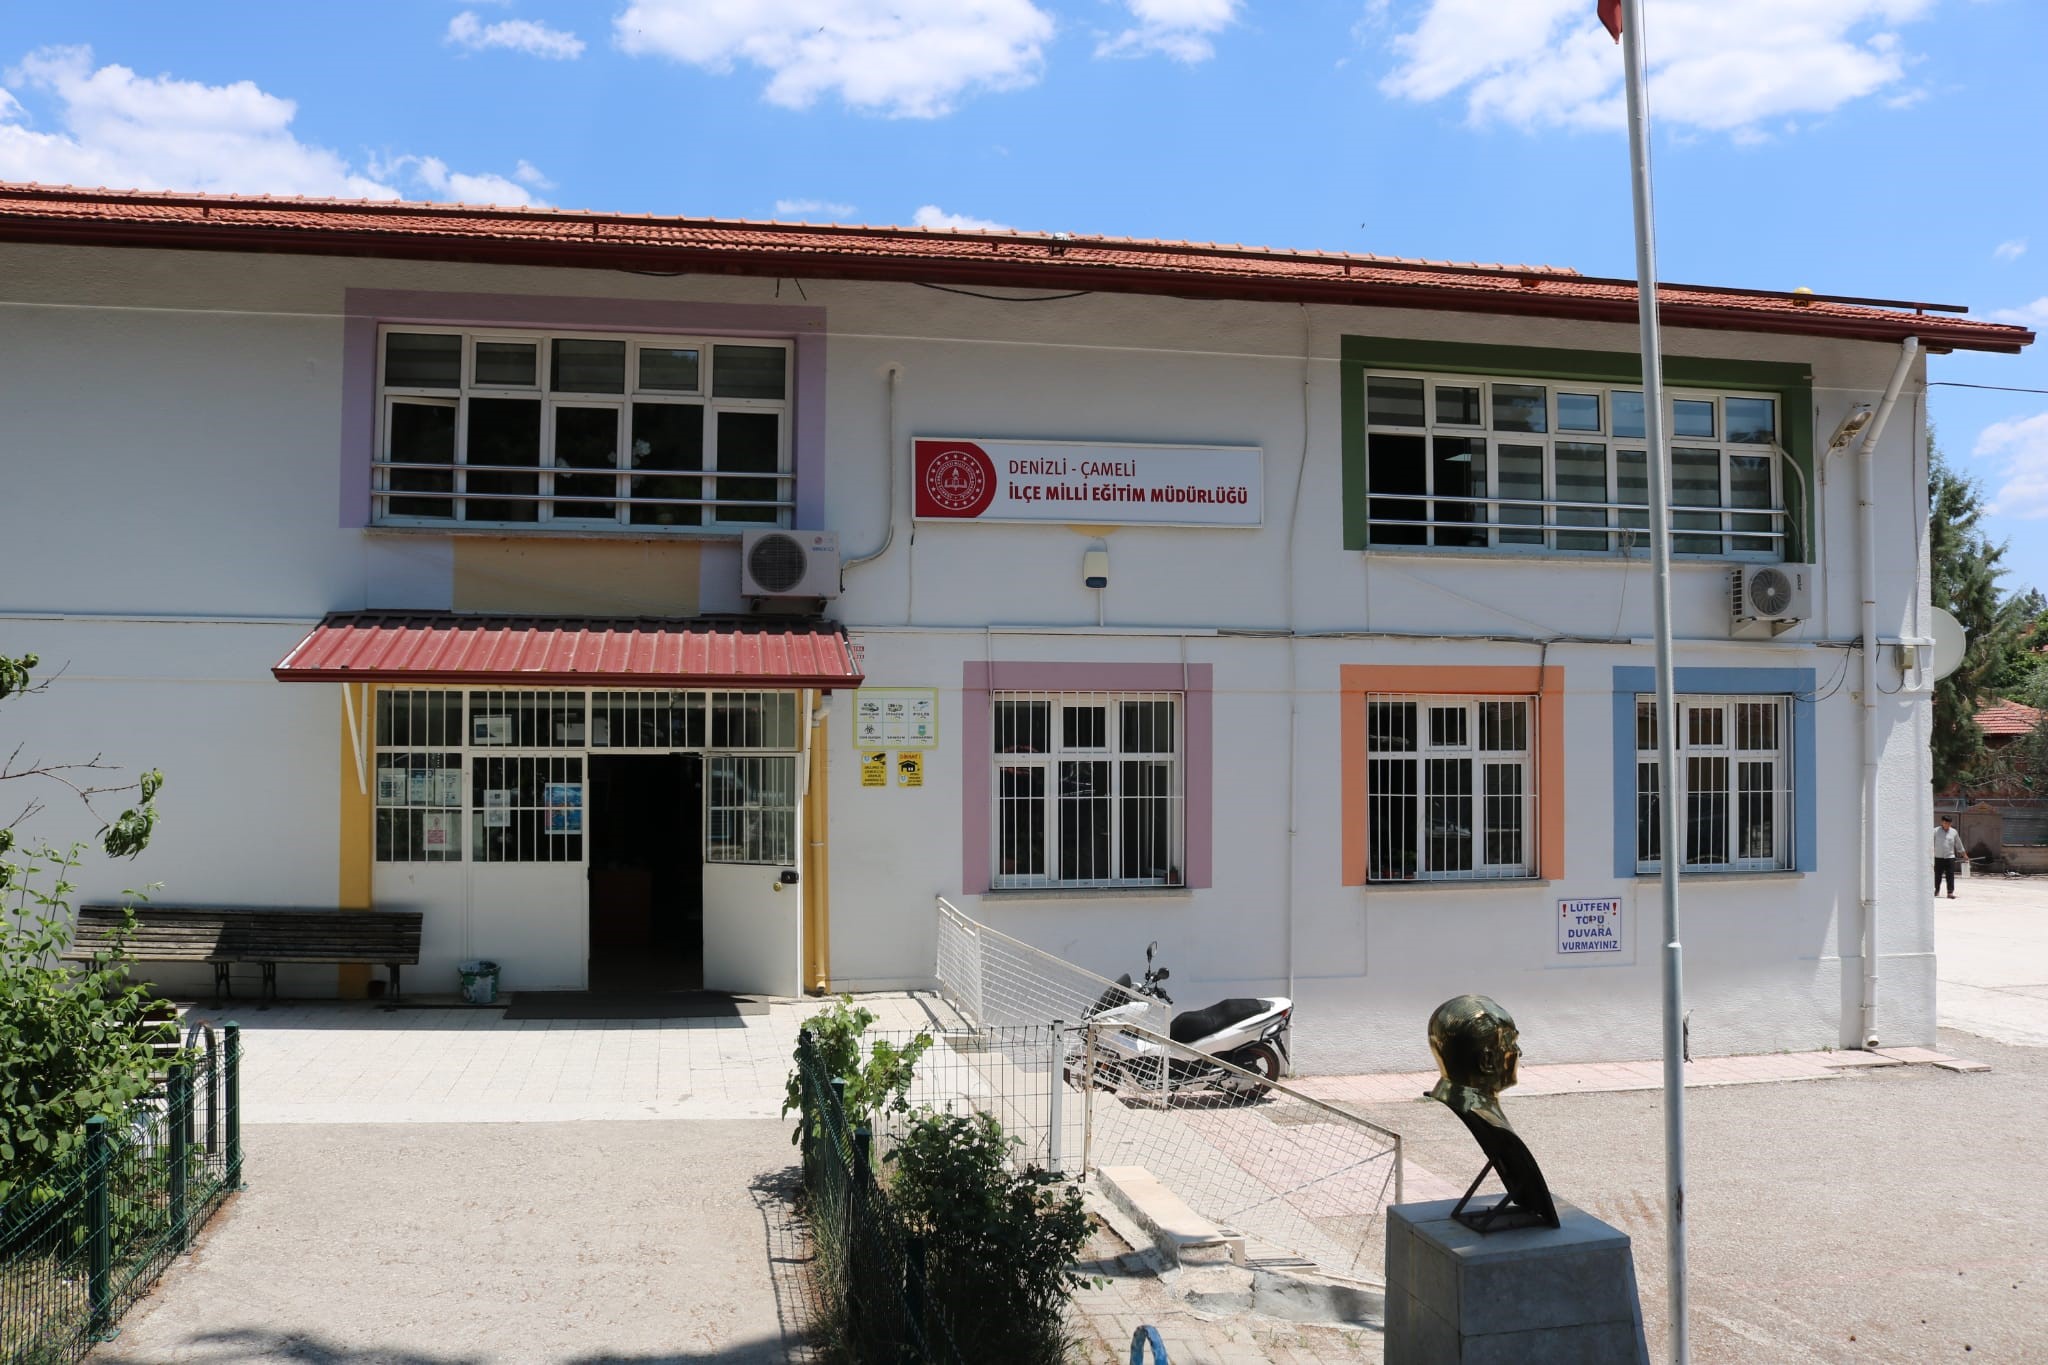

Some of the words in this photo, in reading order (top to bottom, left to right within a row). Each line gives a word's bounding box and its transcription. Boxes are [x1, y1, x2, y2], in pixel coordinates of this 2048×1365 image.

[1009, 457, 1067, 475] DENİZLİ
[1081, 459, 1135, 479] ÇAMELİ
[1009, 481, 1041, 503] İLÇE
[1046, 482, 1088, 501] MİLLİ
[1092, 483, 1146, 502] EĞİTİM
[1150, 485, 1248, 504] MÜDÜRLÜĞÜ
[1568, 927, 1612, 938] DUVARA
[1562, 940, 1617, 950] VURMAYINIZ
